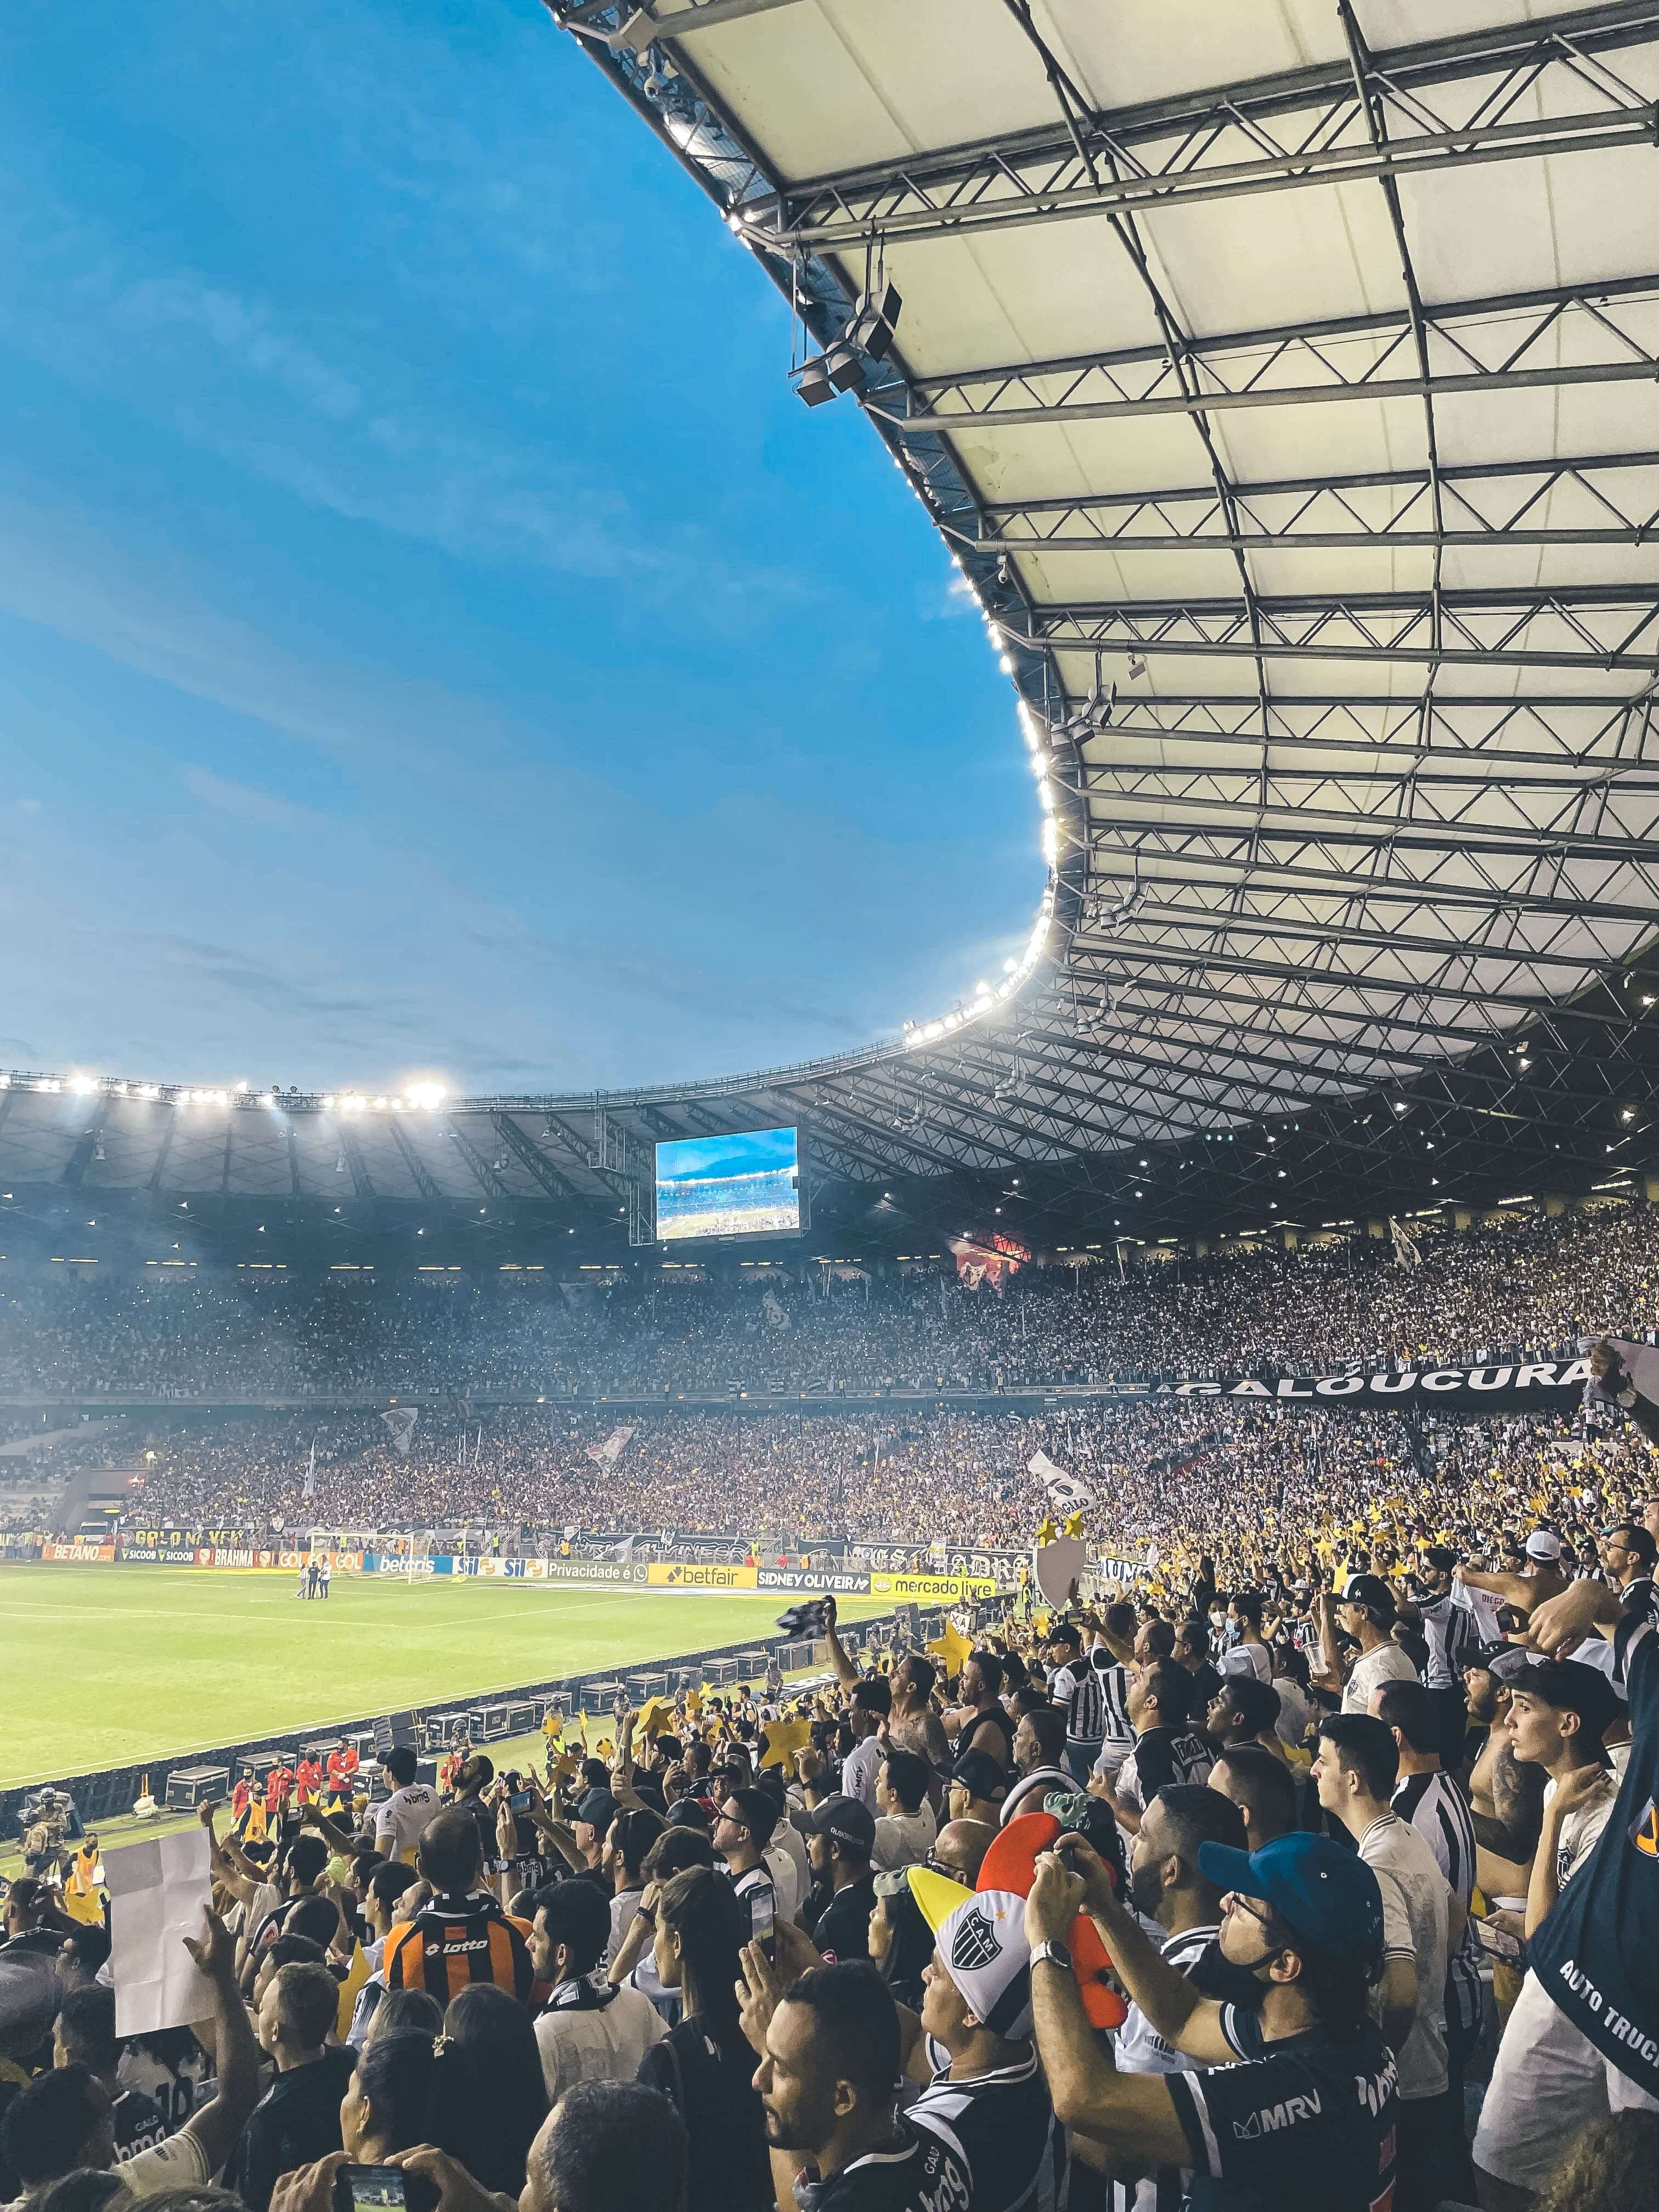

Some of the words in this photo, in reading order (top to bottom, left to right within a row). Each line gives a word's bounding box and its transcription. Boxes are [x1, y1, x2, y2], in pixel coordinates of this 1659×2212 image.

[1173, 1358, 1592, 1396] GALOUCURA
[1062, 1498, 1089, 1515] GALO
[54, 1544, 100, 1561] BETANO
[129, 1550, 156, 1560] SICOOB
[166, 1550, 194, 1561] SICOOB
[215, 1549, 253, 1567] BRAHMA
[280, 1553, 302, 1568] GOL
[335, 1553, 361, 1570] GOL
[504, 1558, 526, 1577] Sil
[549, 1562, 620, 1579] Privacidade
[623, 1566, 631, 1579] é
[684, 1566, 739, 1585] betfair
[758, 1571, 805, 1587] SIDNEY
[895, 1579, 958, 1595] mercado
[961, 1581, 991, 1597] livre
[409, 1791, 430, 1804] bmg
[971, 1917, 994, 1952] CAM
[443, 1940, 488, 1953] lotto
[1559, 1960, 1603, 2011] AUTO
[1261, 2088, 1322, 2133] MRV
